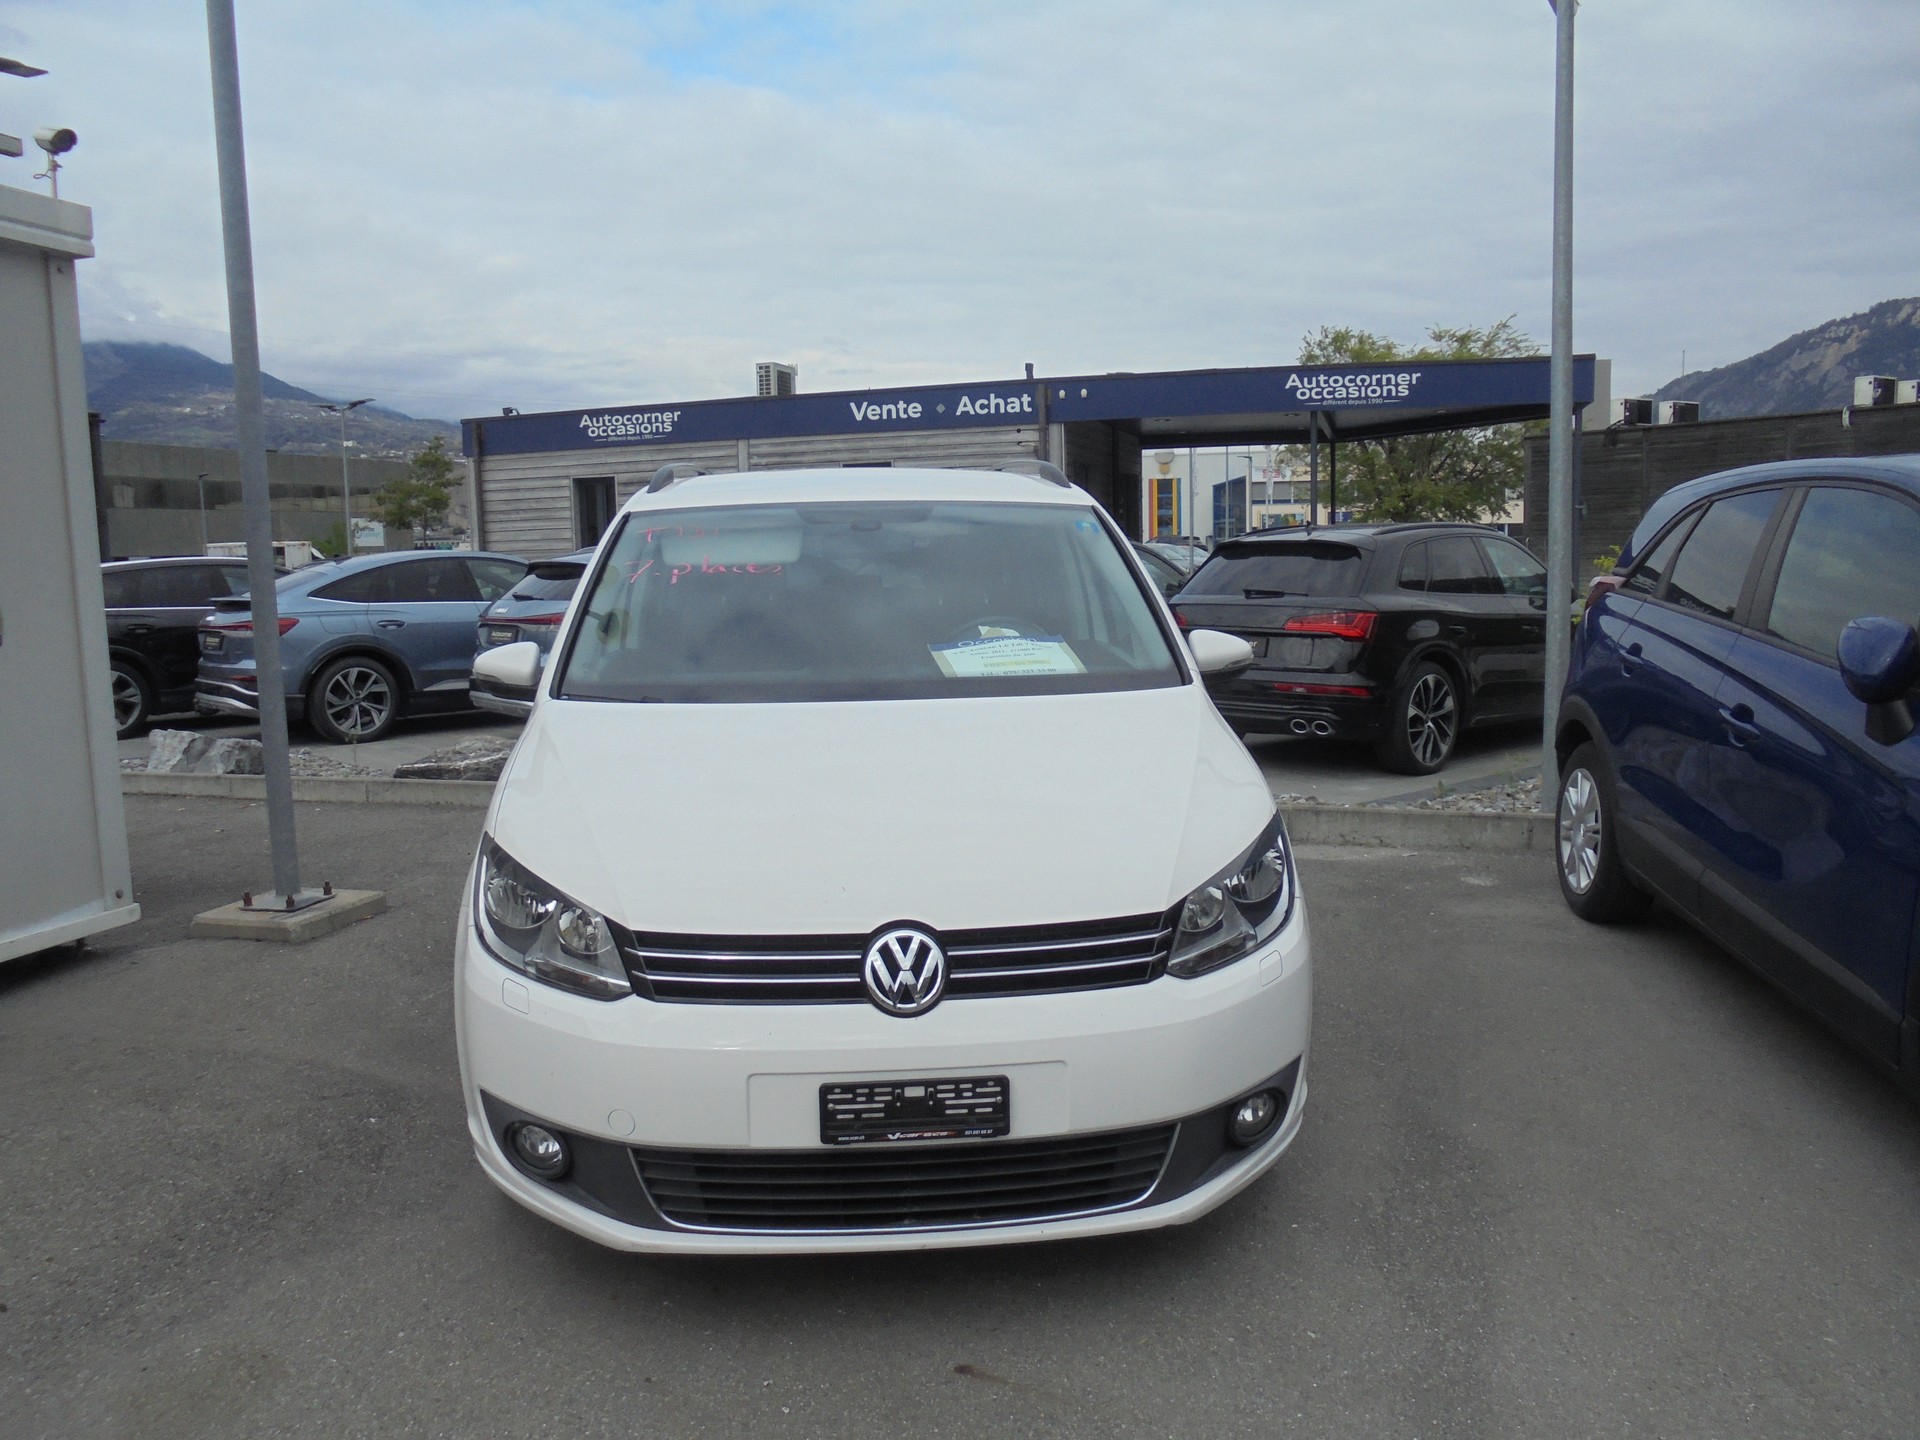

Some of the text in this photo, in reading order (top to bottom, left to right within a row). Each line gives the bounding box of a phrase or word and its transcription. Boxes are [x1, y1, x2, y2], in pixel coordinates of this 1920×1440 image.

[1284, 373, 1421, 389] Autocorner
[1296, 384, 1409, 400] occasions
[850, 393, 1033, 421] Vente Achat
[579, 411, 681, 428] Autocorner
[588, 422, 673, 437] occasions
